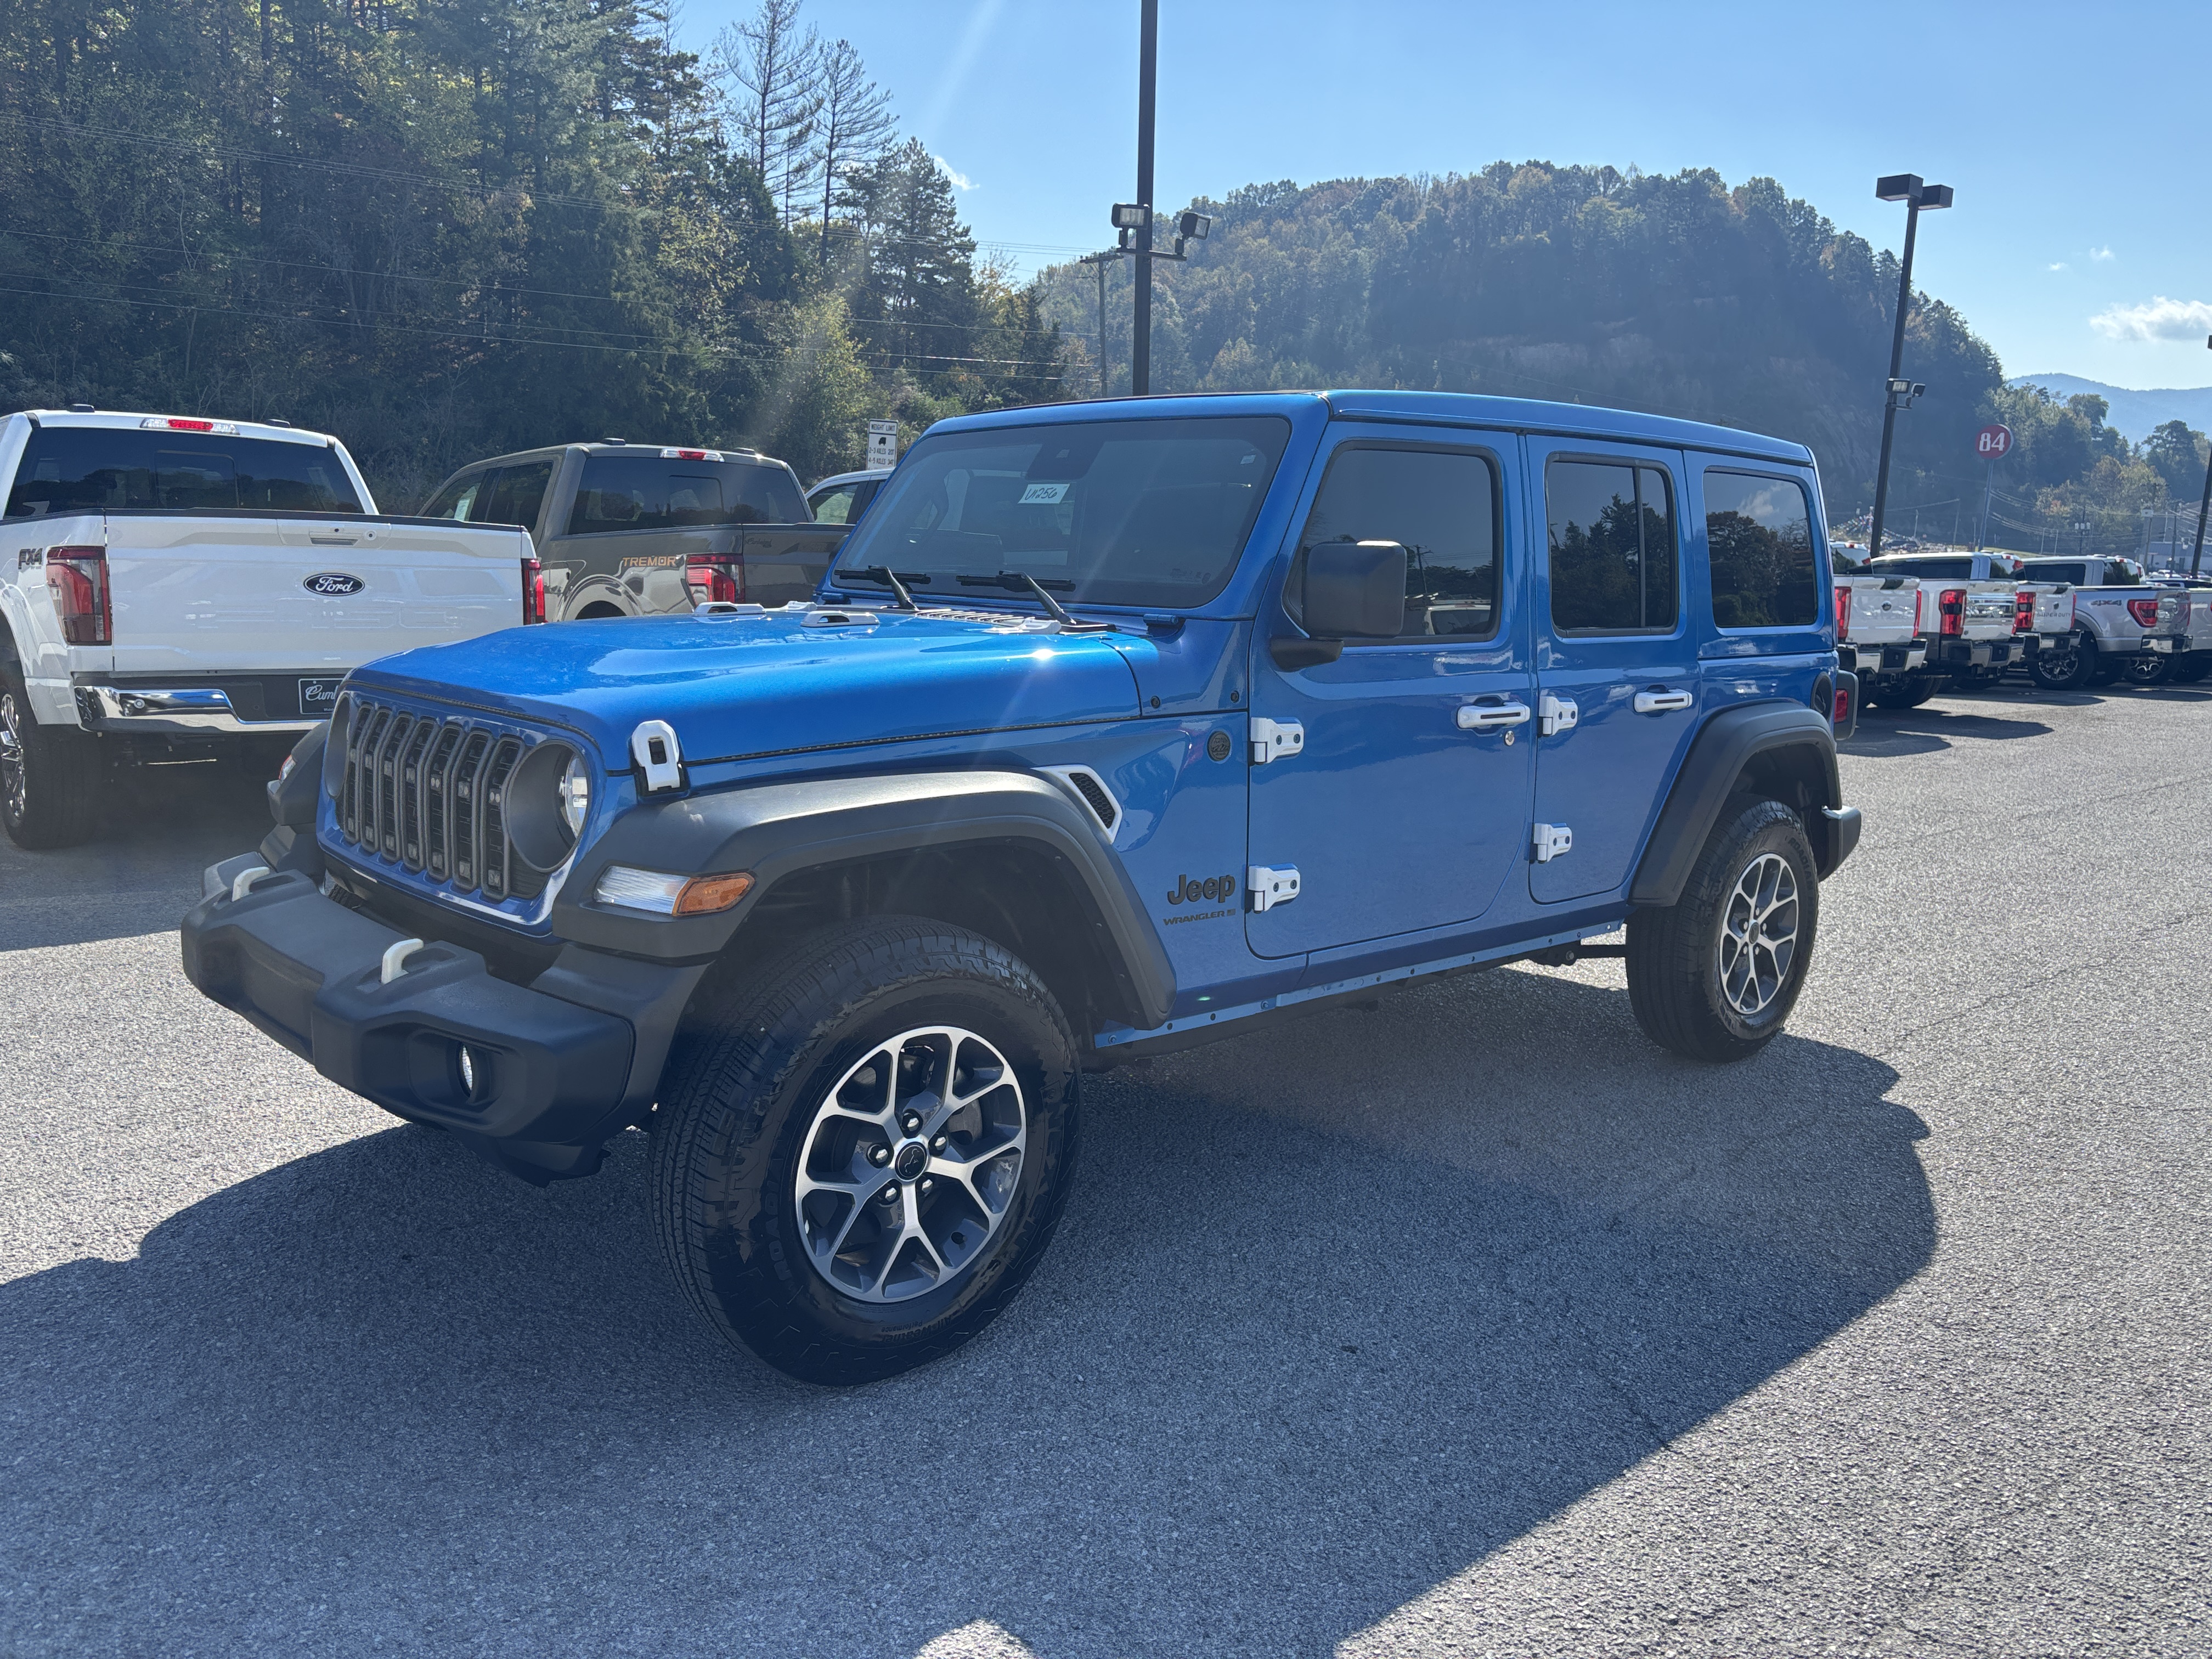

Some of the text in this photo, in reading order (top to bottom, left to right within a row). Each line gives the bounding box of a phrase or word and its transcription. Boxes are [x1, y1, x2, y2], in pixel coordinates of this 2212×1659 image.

[1979, 432, 2005, 452] 84
[18, 548, 43, 569] FX4
[622, 556, 677, 567] TREMOR
[315, 576, 353, 592] Ford
[1167, 874, 1236, 905] Jeep
[1163, 910, 1225, 926] WRANGLER
